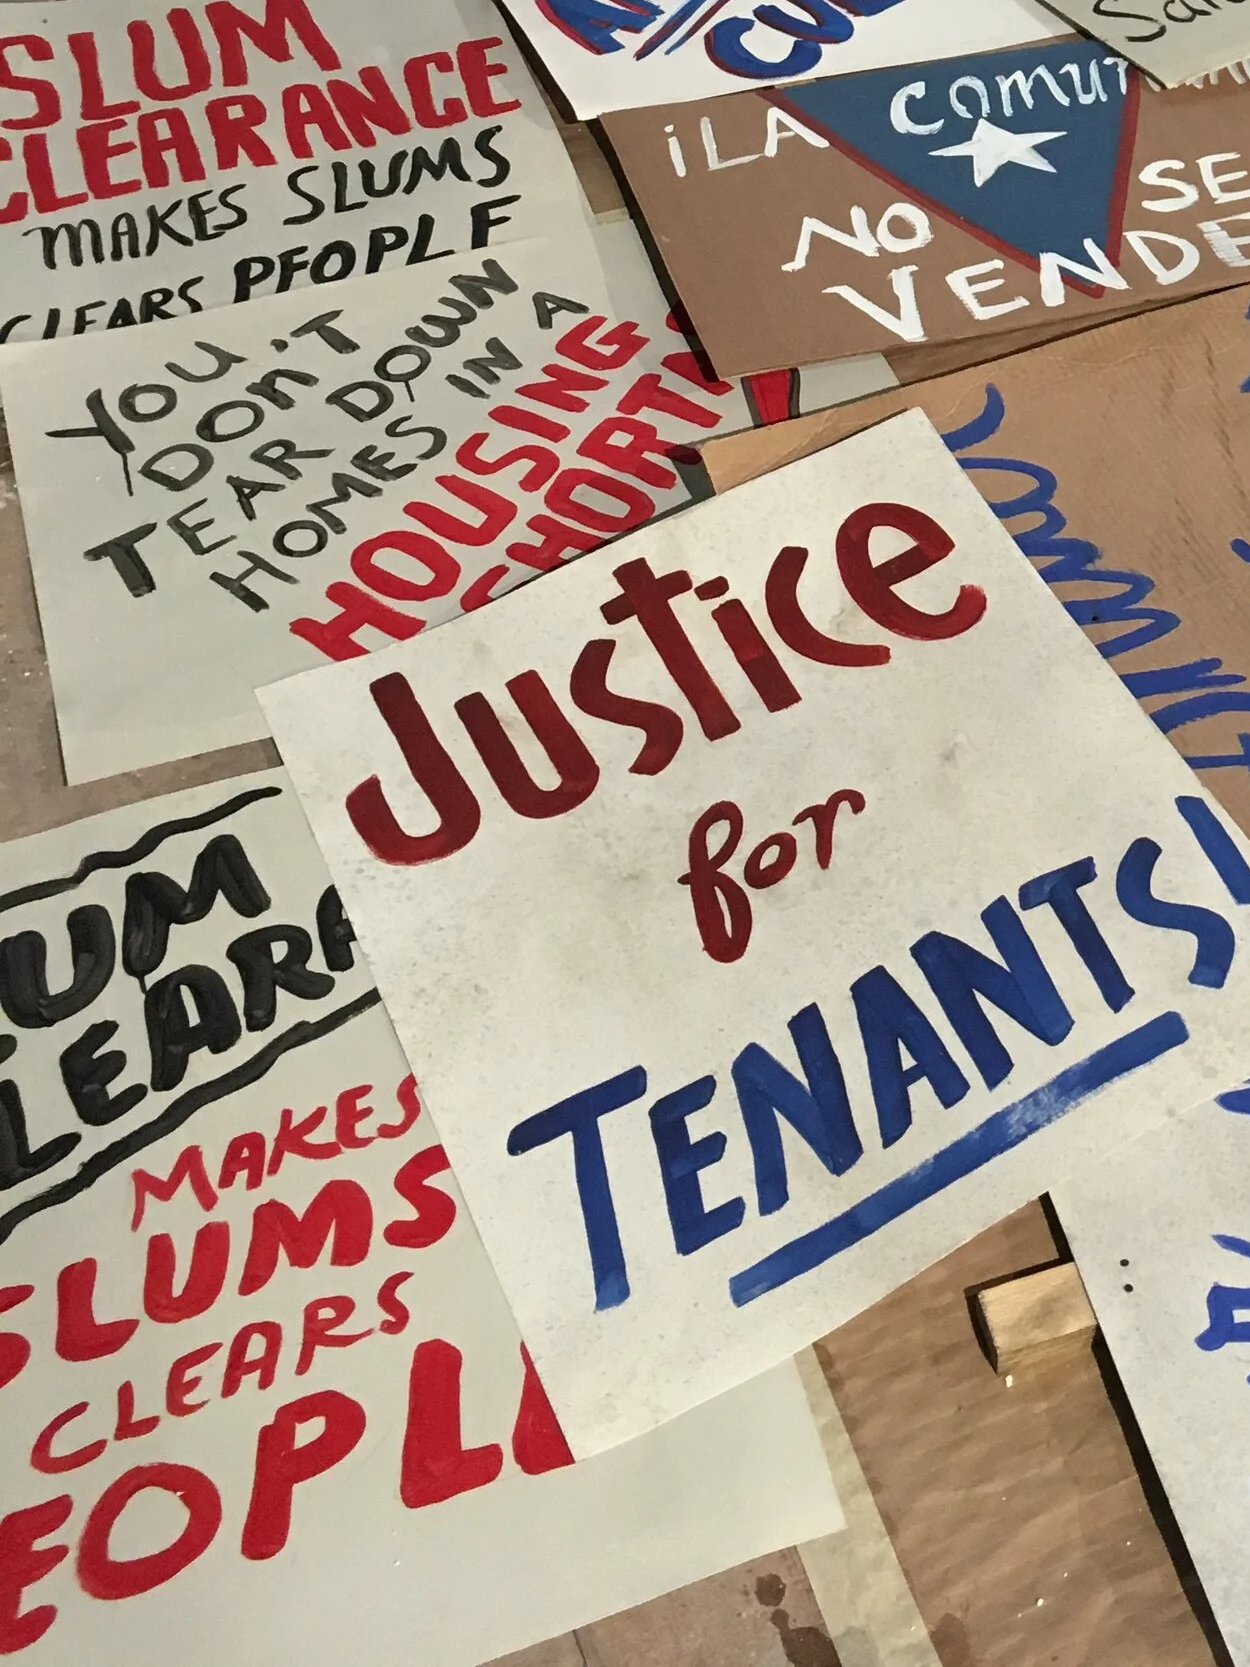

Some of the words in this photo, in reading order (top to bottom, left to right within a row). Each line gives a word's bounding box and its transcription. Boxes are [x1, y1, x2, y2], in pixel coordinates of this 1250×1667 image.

[282, 125, 513, 226] SLUMS
[780, 202, 934, 273] NO
[83, 438, 336, 599] TEAR
[324, 258, 519, 426] DOWN
[208, 413, 448, 612] HOMES
[444, 336, 525, 399] IN
[532, 290, 591, 330] A
[287, 314, 644, 662] HOUSING
[677, 787, 866, 965] for
[29, 1270, 415, 1476] CLEARS
